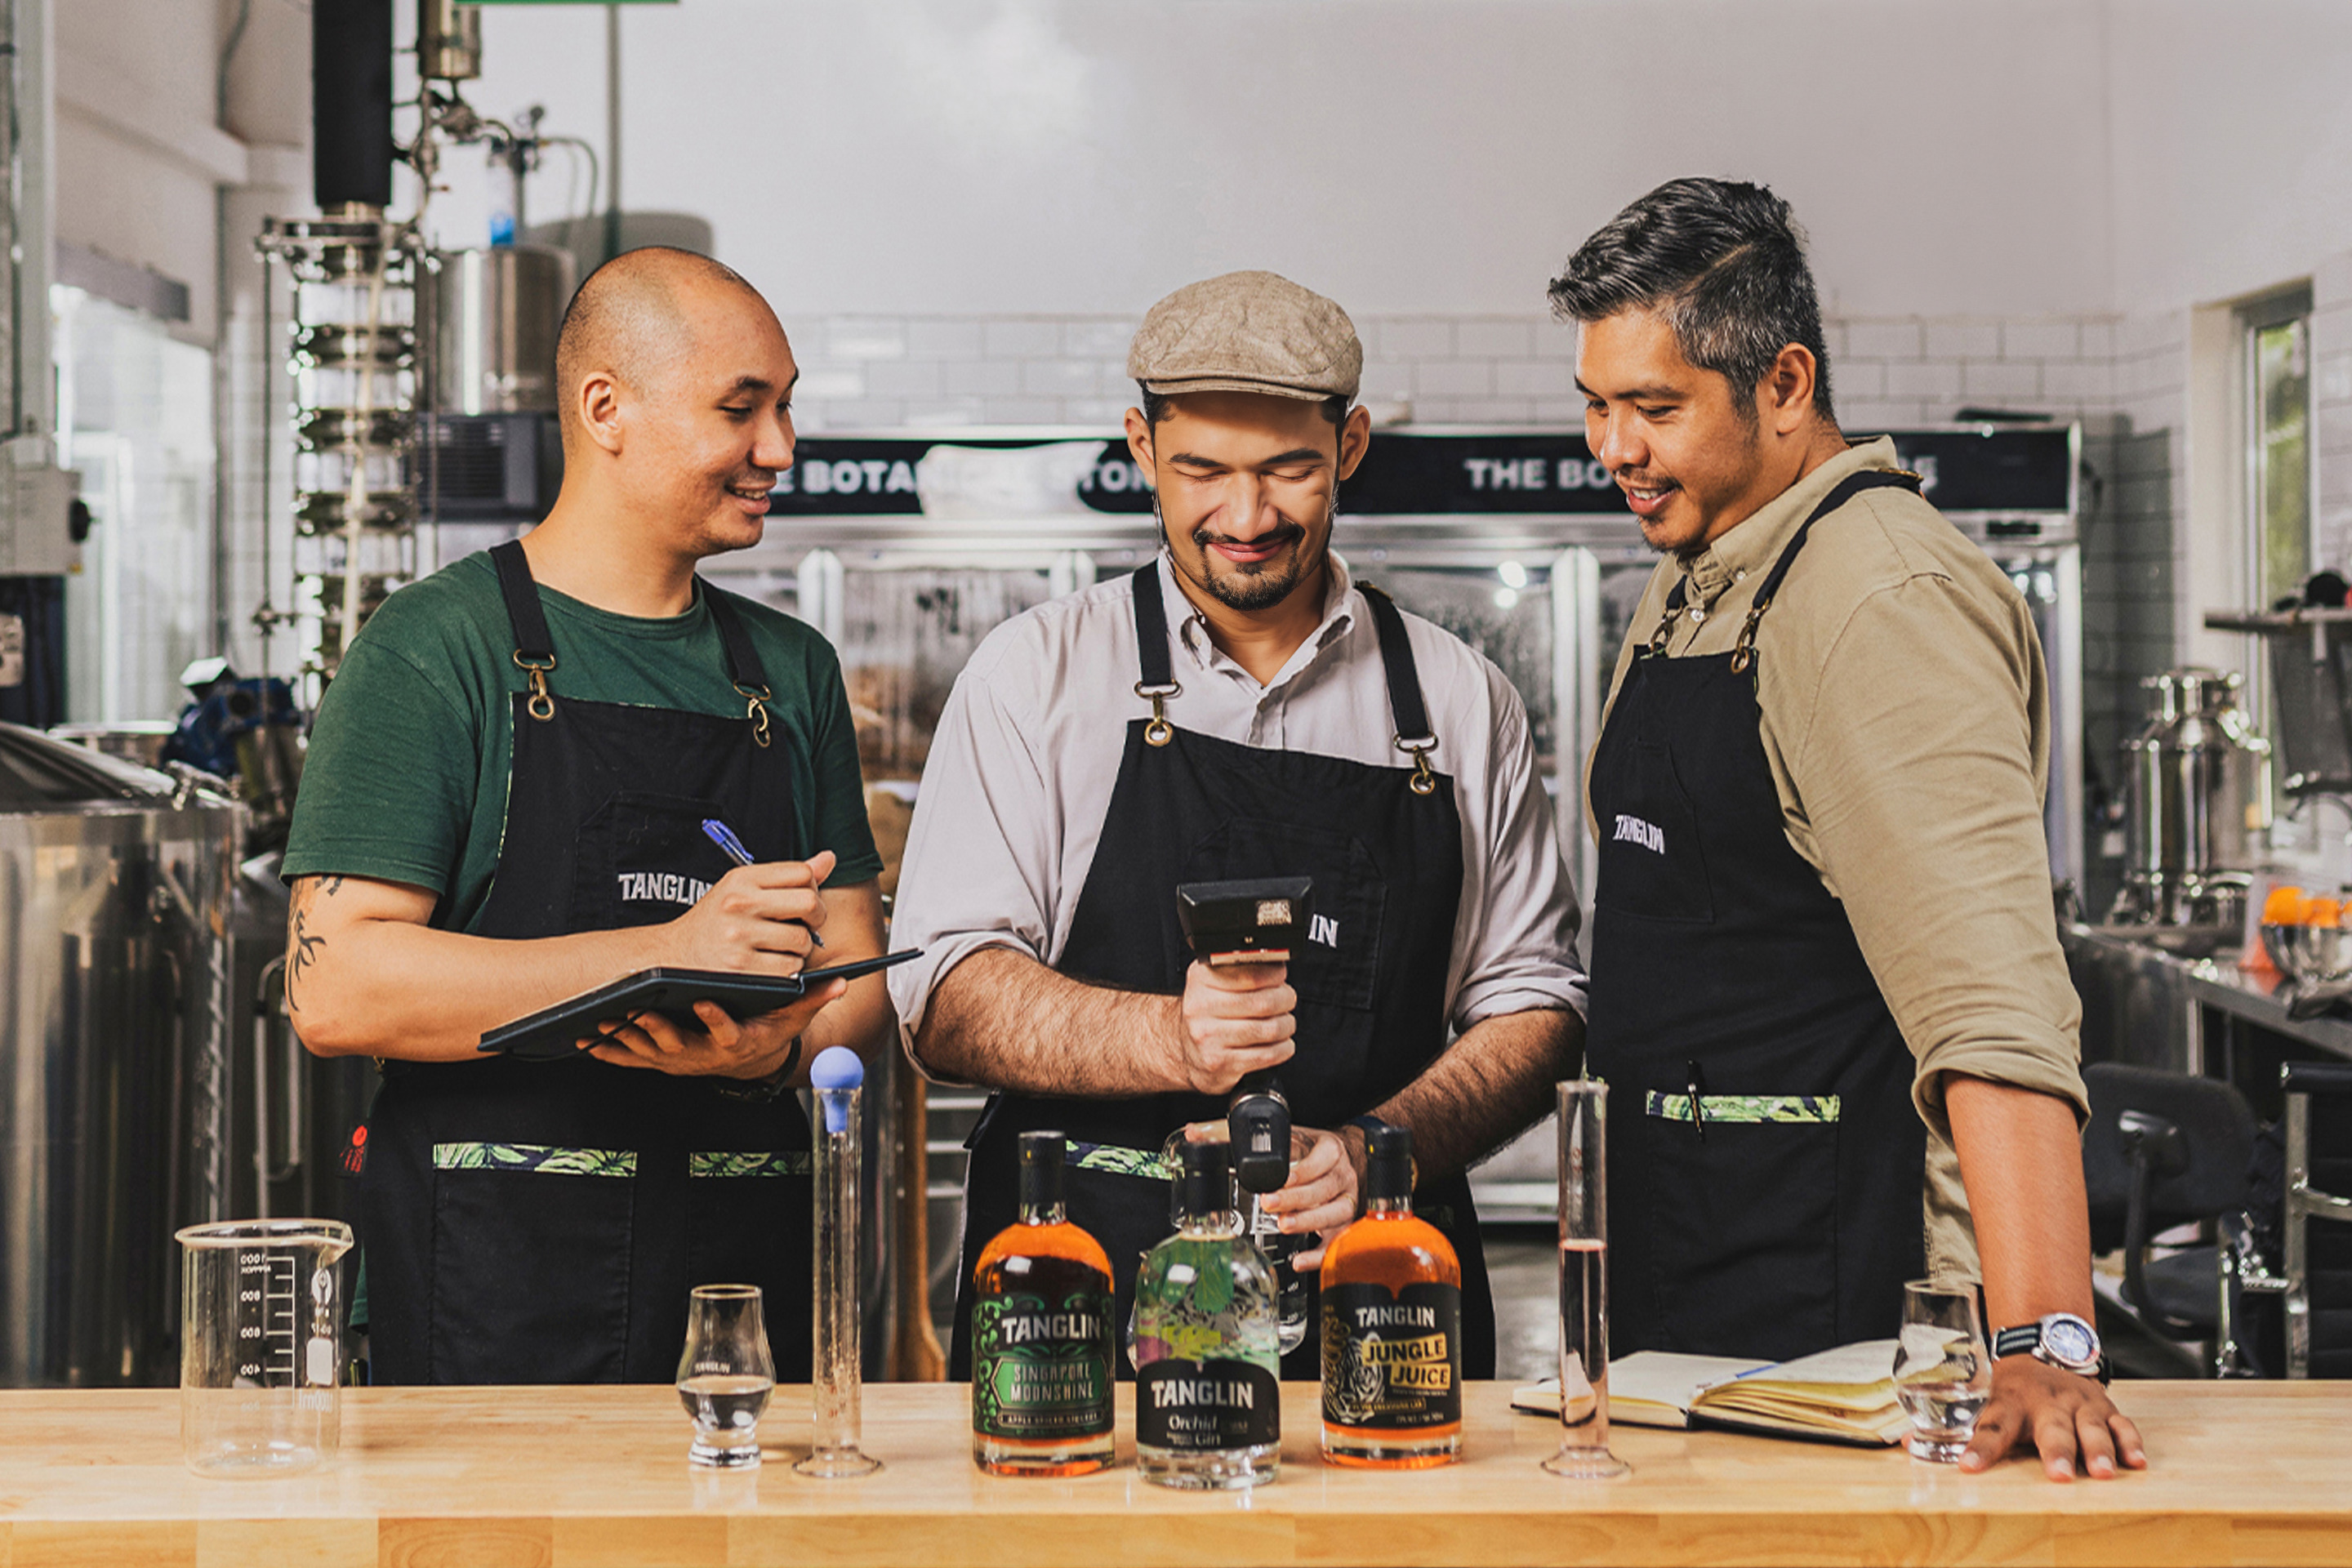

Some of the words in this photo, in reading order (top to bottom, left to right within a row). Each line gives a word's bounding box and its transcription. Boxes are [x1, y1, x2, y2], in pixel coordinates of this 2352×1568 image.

[1464, 459, 1546, 488] THE
[1612, 814, 1664, 855] TANGLIN
[1356, 1306, 1435, 1328] TANGLIN
[1001, 1314, 1101, 1344] TANGLIN
[1365, 1339, 1444, 1362] JUNGLE
[1013, 1362, 1092, 1382] SINGAPORE
[1394, 1365, 1448, 1386] JUICE
[1010, 1381, 1094, 1401] MOONSHINE
[1151, 1379, 1254, 1409] TANGLIN
